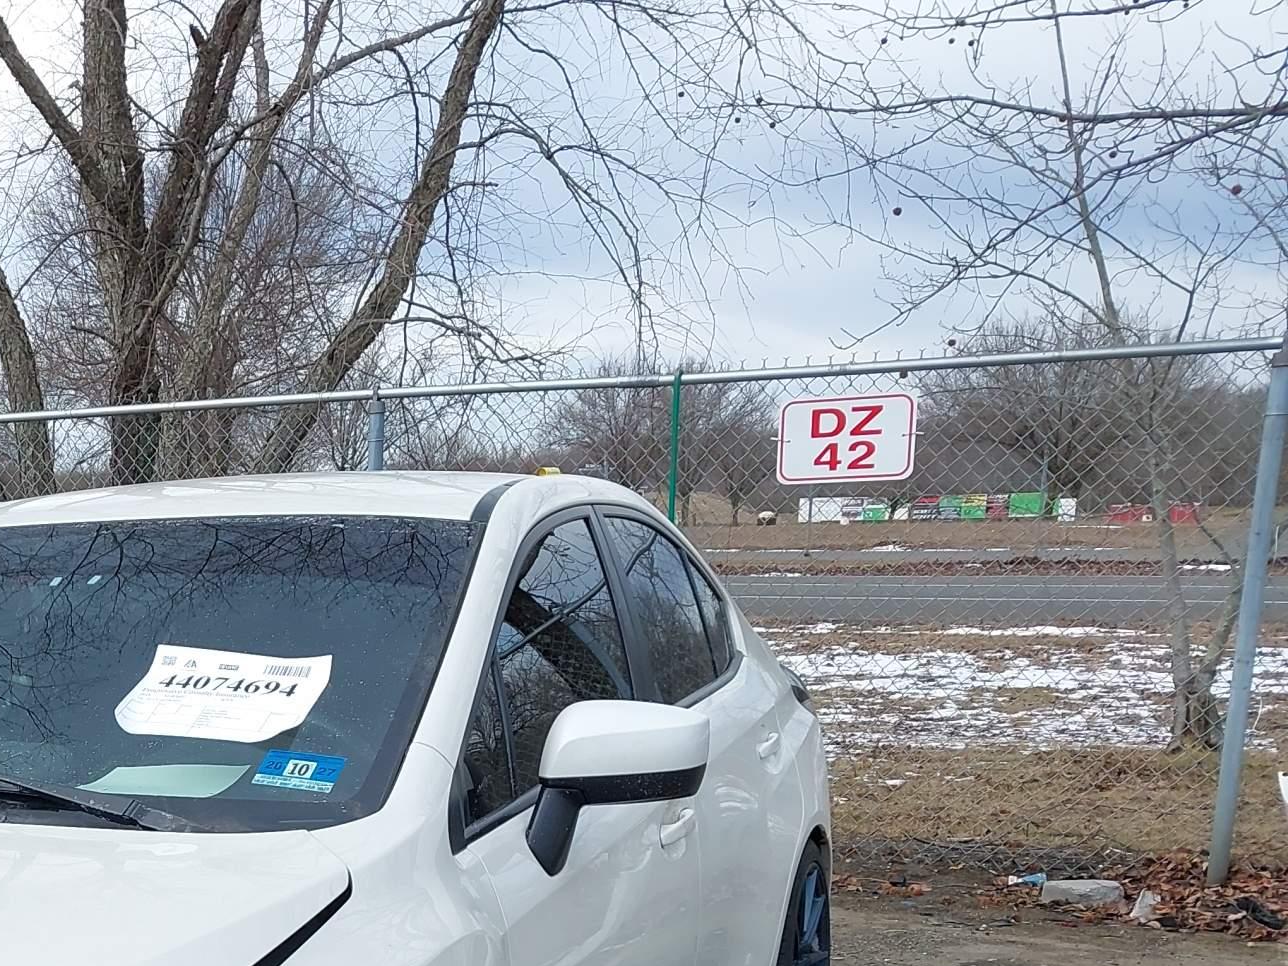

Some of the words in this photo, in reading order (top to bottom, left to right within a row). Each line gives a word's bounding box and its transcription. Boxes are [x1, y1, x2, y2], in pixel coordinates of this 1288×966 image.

[811, 404, 884, 439] DZ
[813, 440, 876, 471] 42
[159, 674, 299, 698] 44074694
[264, 760, 283, 771] 20
[287, 762, 310, 776] 10
[316, 767, 337, 777] 27
